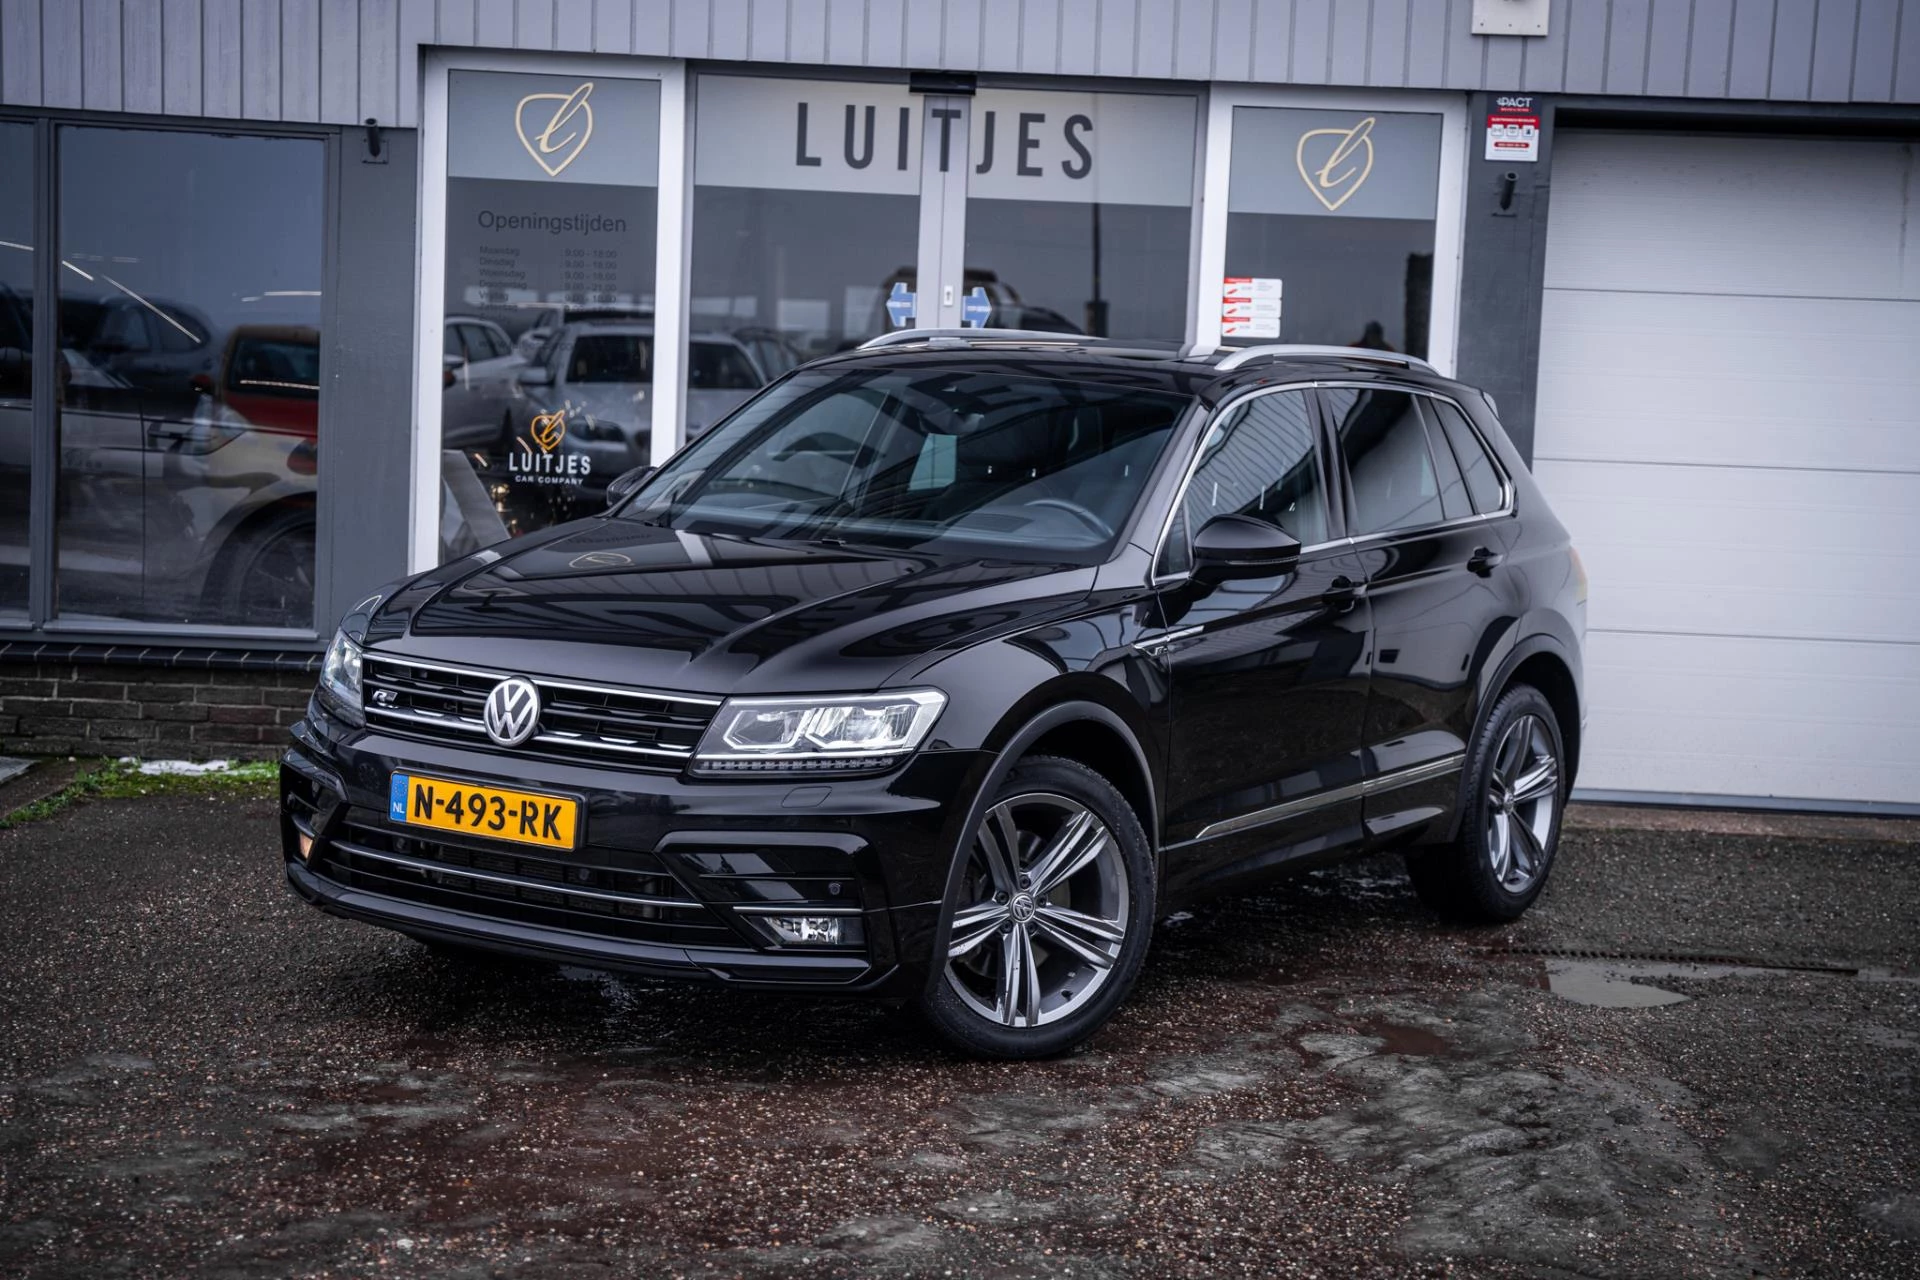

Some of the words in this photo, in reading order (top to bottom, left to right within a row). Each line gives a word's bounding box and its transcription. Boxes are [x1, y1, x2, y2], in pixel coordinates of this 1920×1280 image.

[795, 102, 1093, 179] LUITJES
[477, 210, 627, 236] Openingstijden
[508, 451, 592, 476] LUITJES
[514, 474, 535, 483] CAR
[537, 475, 584, 486] COMPANY
[392, 801, 405, 815] NL
[414, 783, 562, 841] N-493-RK
